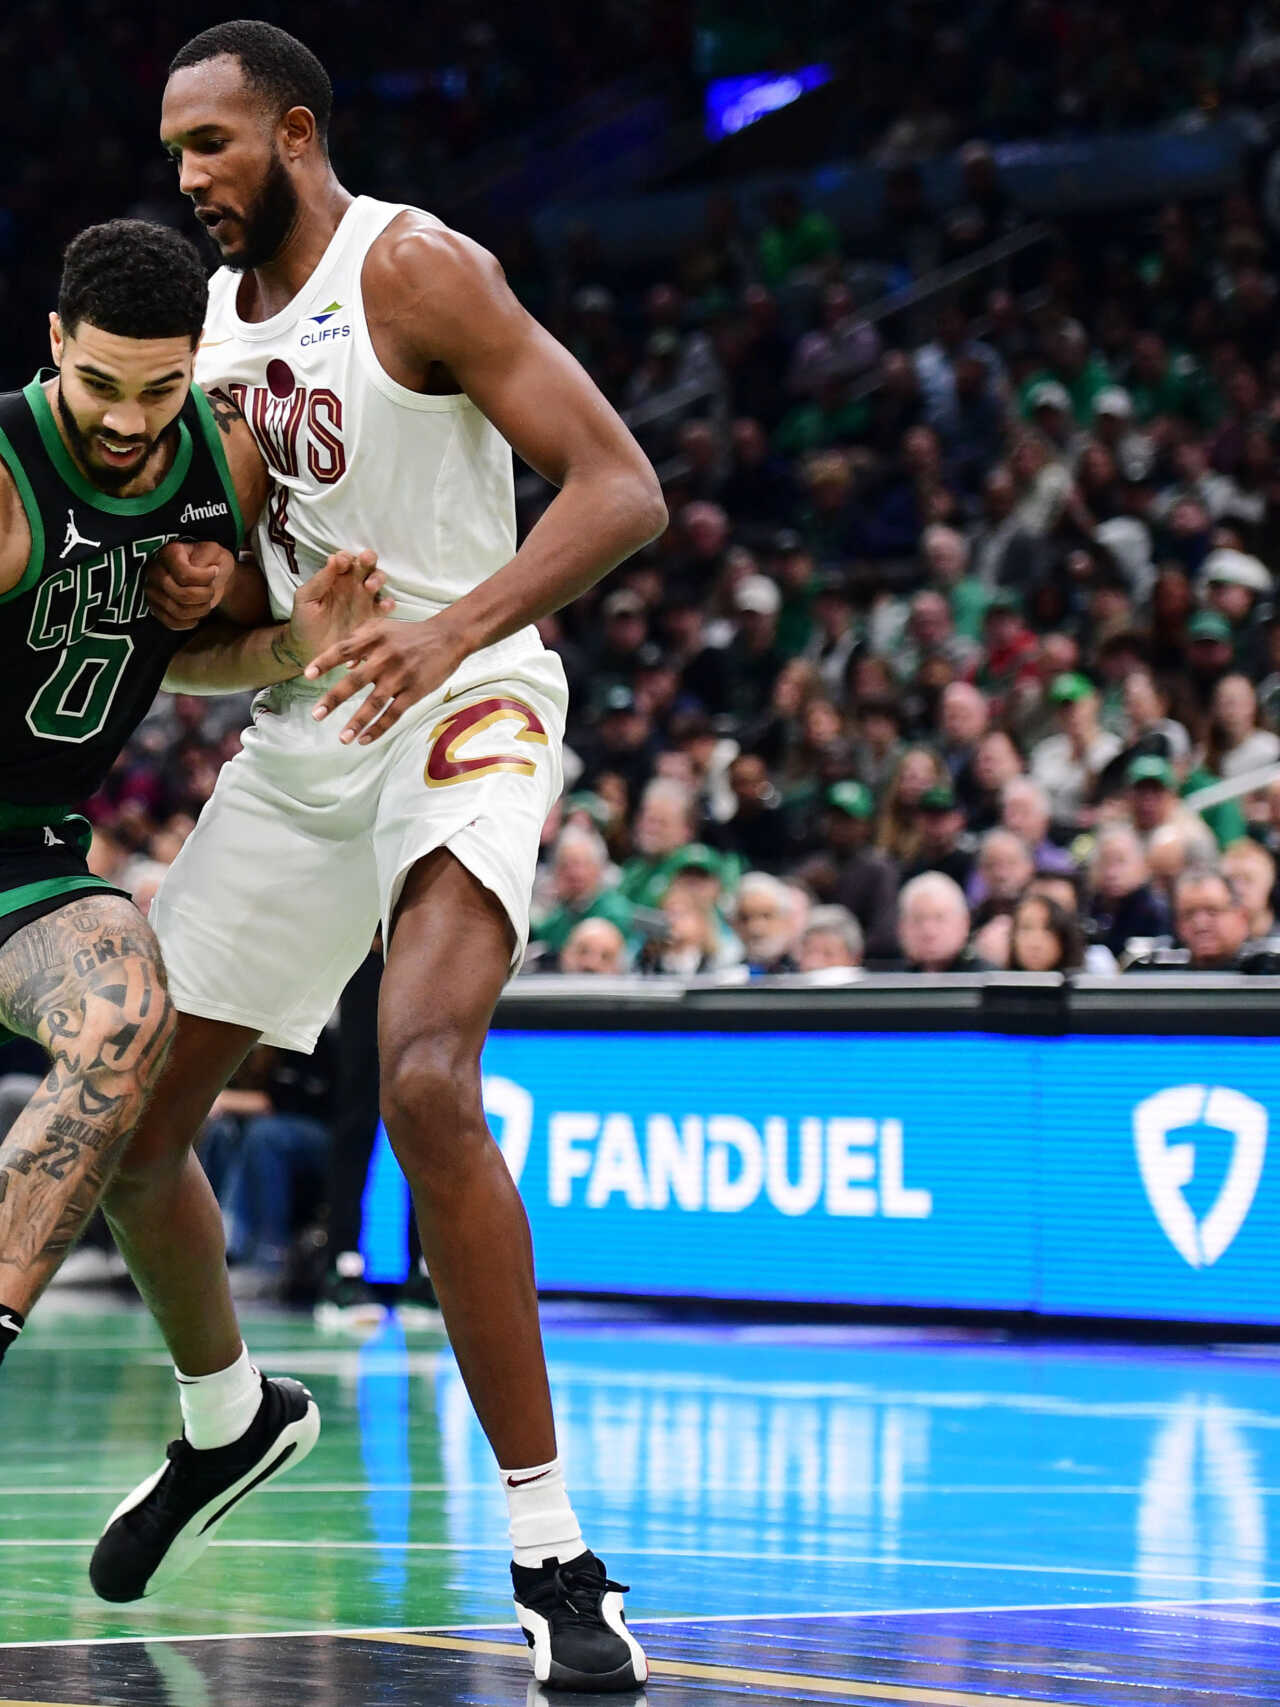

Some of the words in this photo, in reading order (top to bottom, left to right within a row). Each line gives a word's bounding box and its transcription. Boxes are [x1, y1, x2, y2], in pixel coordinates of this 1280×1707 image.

[300, 324, 351, 347] CLIFFS
[180, 500, 229, 523] Amica
[27, 534, 180, 652] CELT
[25, 632, 135, 744] 0
[547, 1112, 933, 1219] FANDUEL
